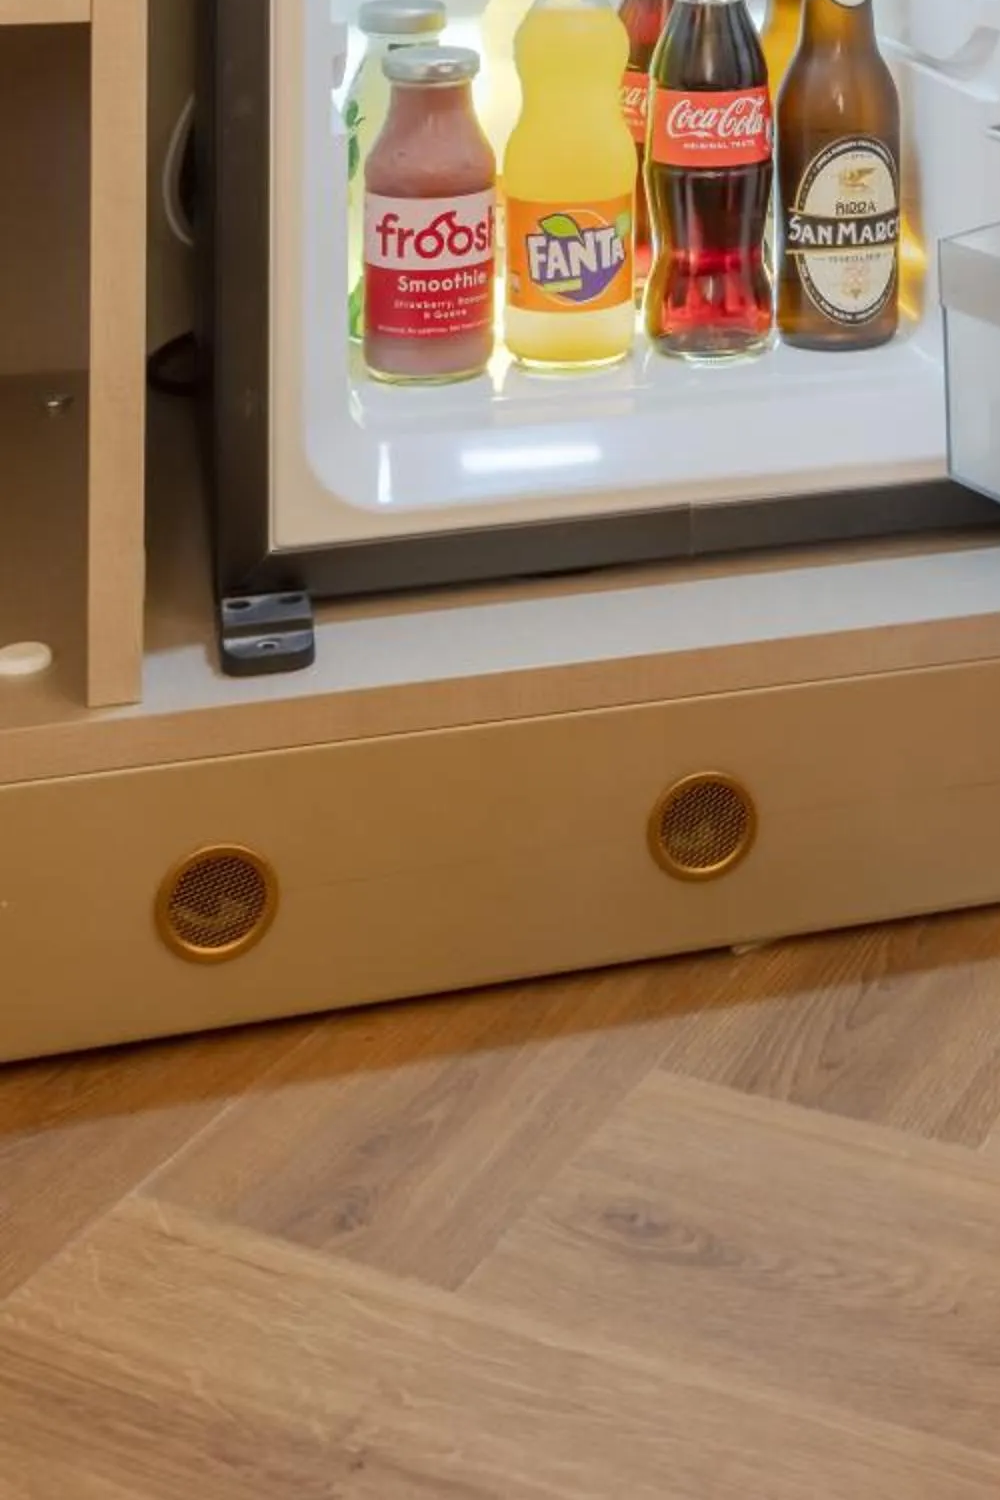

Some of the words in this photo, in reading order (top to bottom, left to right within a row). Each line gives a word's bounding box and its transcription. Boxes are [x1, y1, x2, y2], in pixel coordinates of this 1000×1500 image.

[787, 216, 833, 245] SAN
[526, 228, 625, 281] FANTA
[397, 269, 487, 293] Smoothie
